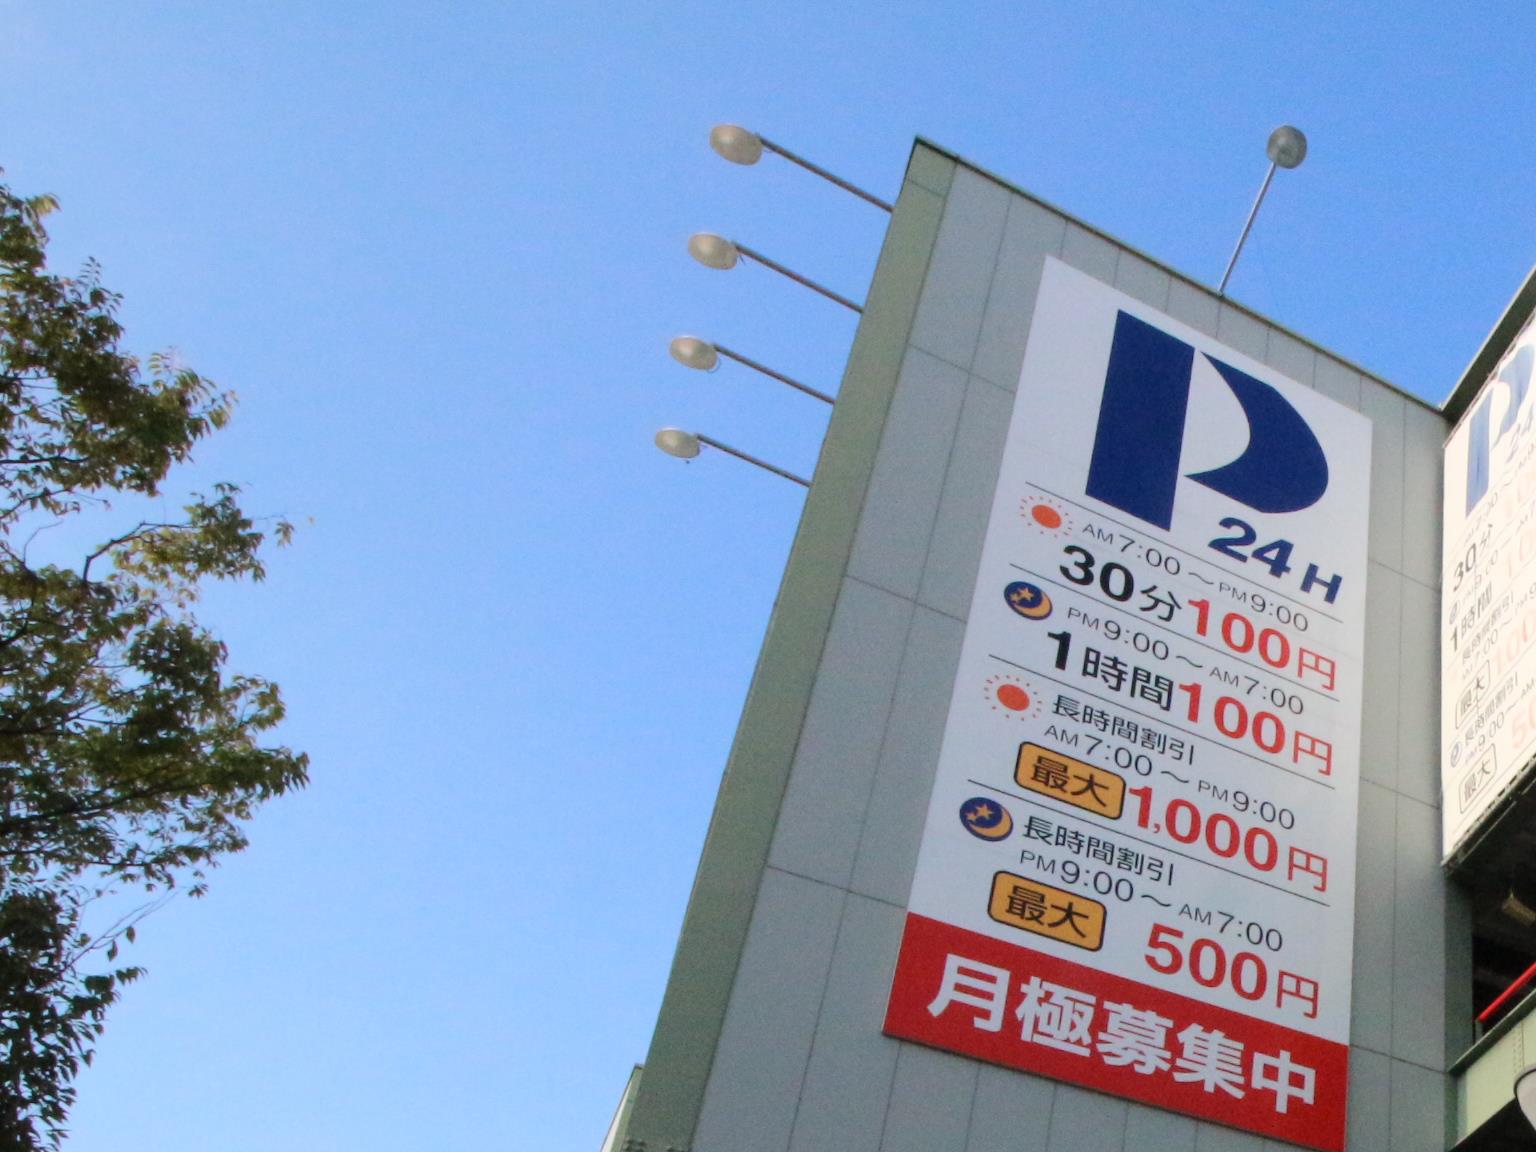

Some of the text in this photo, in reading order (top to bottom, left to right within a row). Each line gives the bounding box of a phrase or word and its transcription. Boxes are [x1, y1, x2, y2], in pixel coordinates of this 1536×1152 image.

[1085, 309, 1329, 532] P
[1051, 693, 1197, 766] 長時間割引
[1029, 753, 1110, 808] 最大
[1022, 814, 1176, 887] 長時間割引
[1004, 884, 1089, 940] 最大
[926, 951, 1317, 1116] 月極募集中
